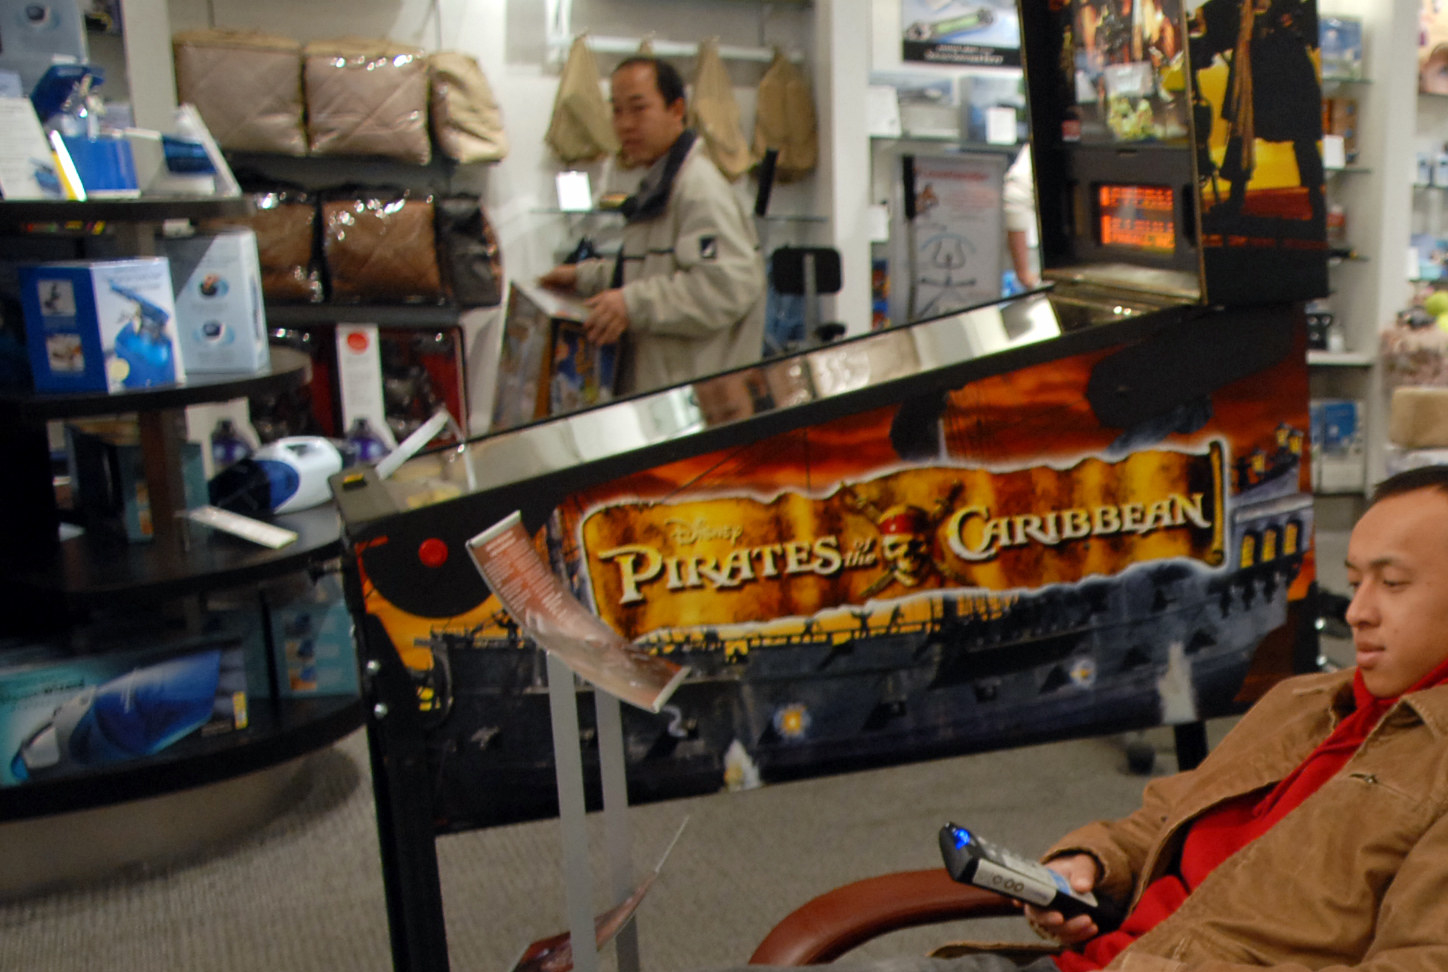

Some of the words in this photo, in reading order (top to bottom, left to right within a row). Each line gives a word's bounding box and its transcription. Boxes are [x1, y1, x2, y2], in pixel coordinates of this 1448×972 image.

[665, 517, 743, 545] Disney
[947, 493, 1212, 561] CARIBBEAN
[852, 536, 877, 552] of
[598, 535, 842, 604] PIRATES
[844, 551, 877, 568] the
